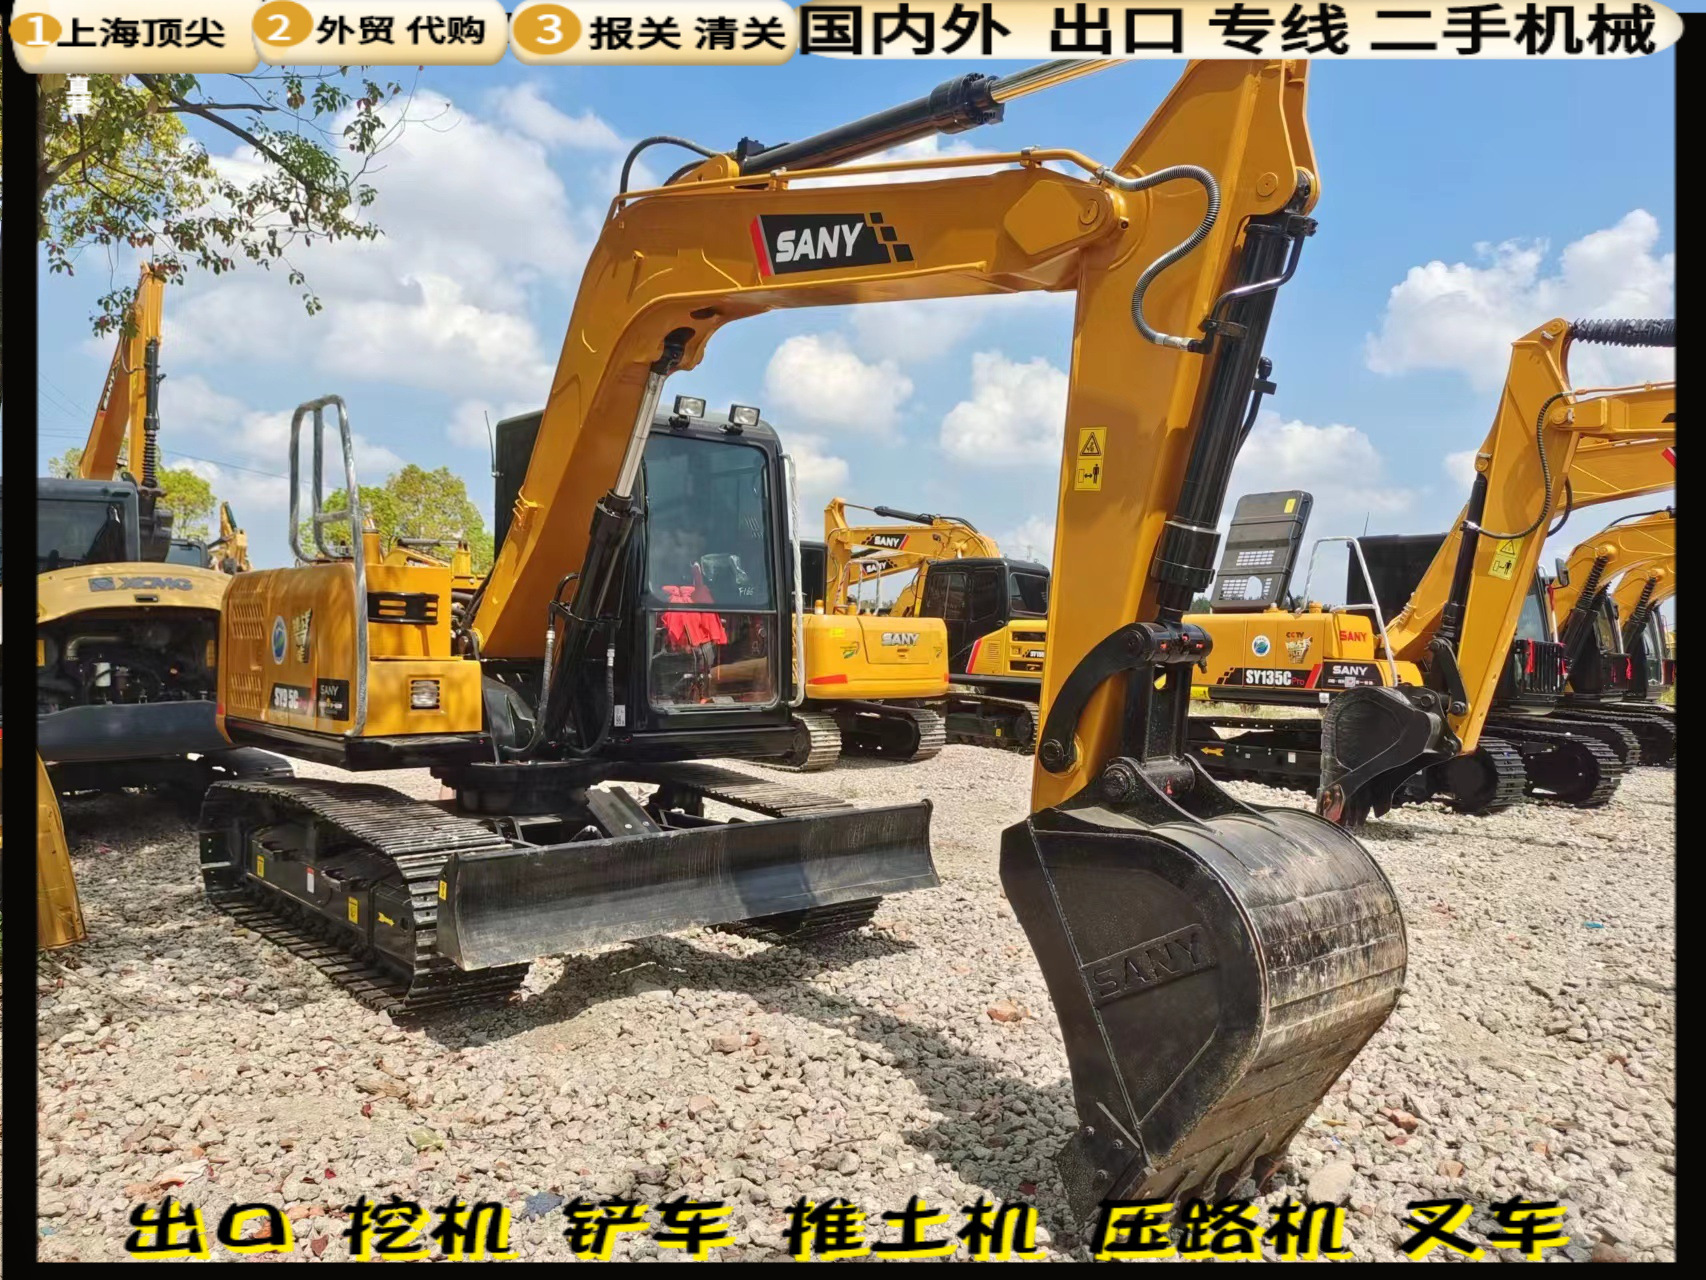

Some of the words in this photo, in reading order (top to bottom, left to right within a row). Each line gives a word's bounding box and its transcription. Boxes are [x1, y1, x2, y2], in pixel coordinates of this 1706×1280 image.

[775, 222, 864, 263] SANY
[874, 535, 899, 548] SANY
[116, 576, 193, 591] XCMG
[881, 632, 920, 647] SANY
[1340, 631, 1367, 642] SANY
[1246, 669, 1292, 686] SY135C
[1333, 665, 1368, 676] SANY
[320, 685, 339, 697] SANY
[1094, 931, 1208, 998] SANY
